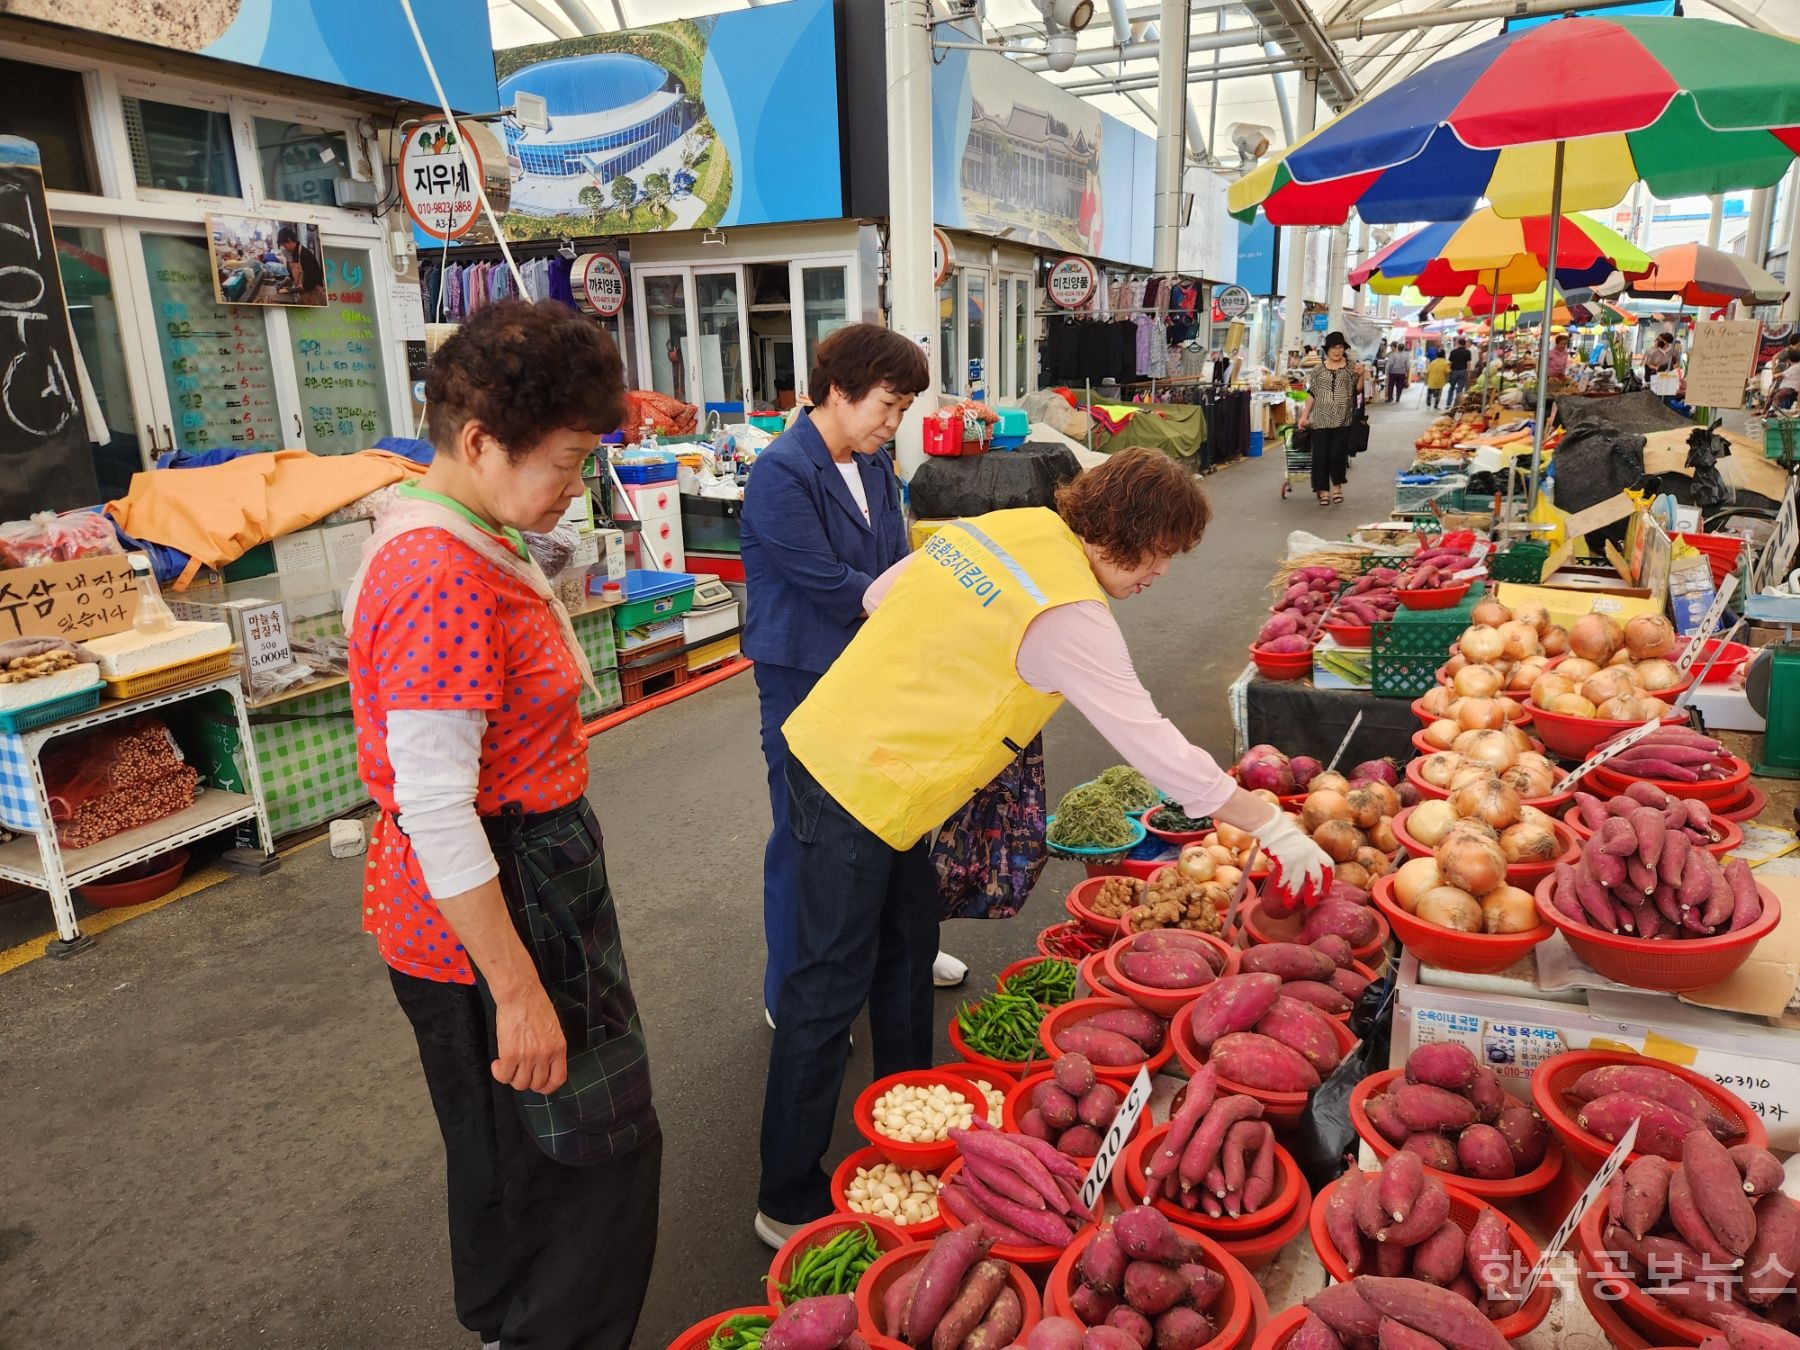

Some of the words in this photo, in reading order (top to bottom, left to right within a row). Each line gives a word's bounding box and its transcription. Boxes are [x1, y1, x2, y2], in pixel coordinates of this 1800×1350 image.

[413, 162, 470, 195] 지우네
[588, 278, 622, 295] 까치양품
[1053, 276, 1089, 290] 미진양품
[0, 579, 57, 636] 수삼
[66, 569, 138, 605] 냉장고
[57, 604, 128, 633] 있습니다
[251, 648, 290, 667] 5,000원
[1083, 1087, 1140, 1210] 5.000
